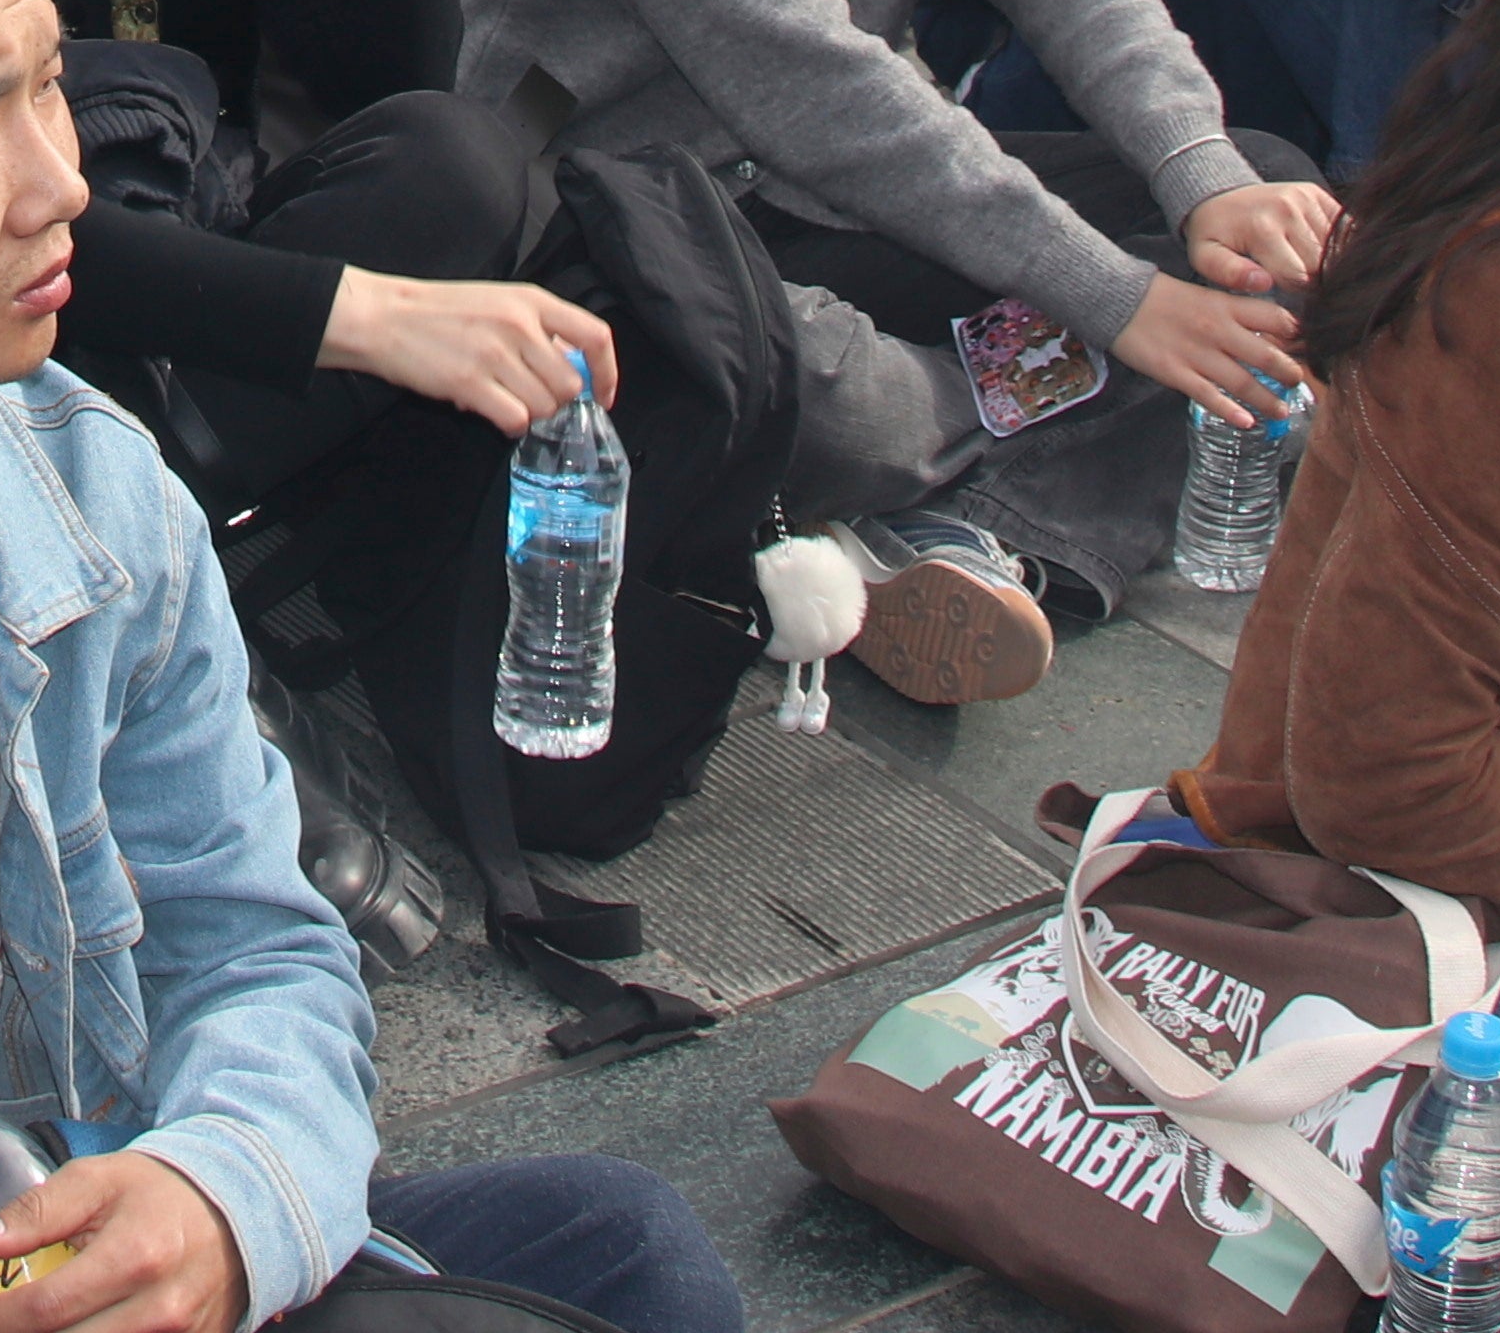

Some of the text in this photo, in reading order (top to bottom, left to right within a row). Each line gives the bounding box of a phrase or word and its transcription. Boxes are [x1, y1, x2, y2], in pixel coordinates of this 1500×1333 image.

[1103, 941, 1266, 1043] RALLY FOR
[953, 1059, 1188, 1224] NAMIBIA
